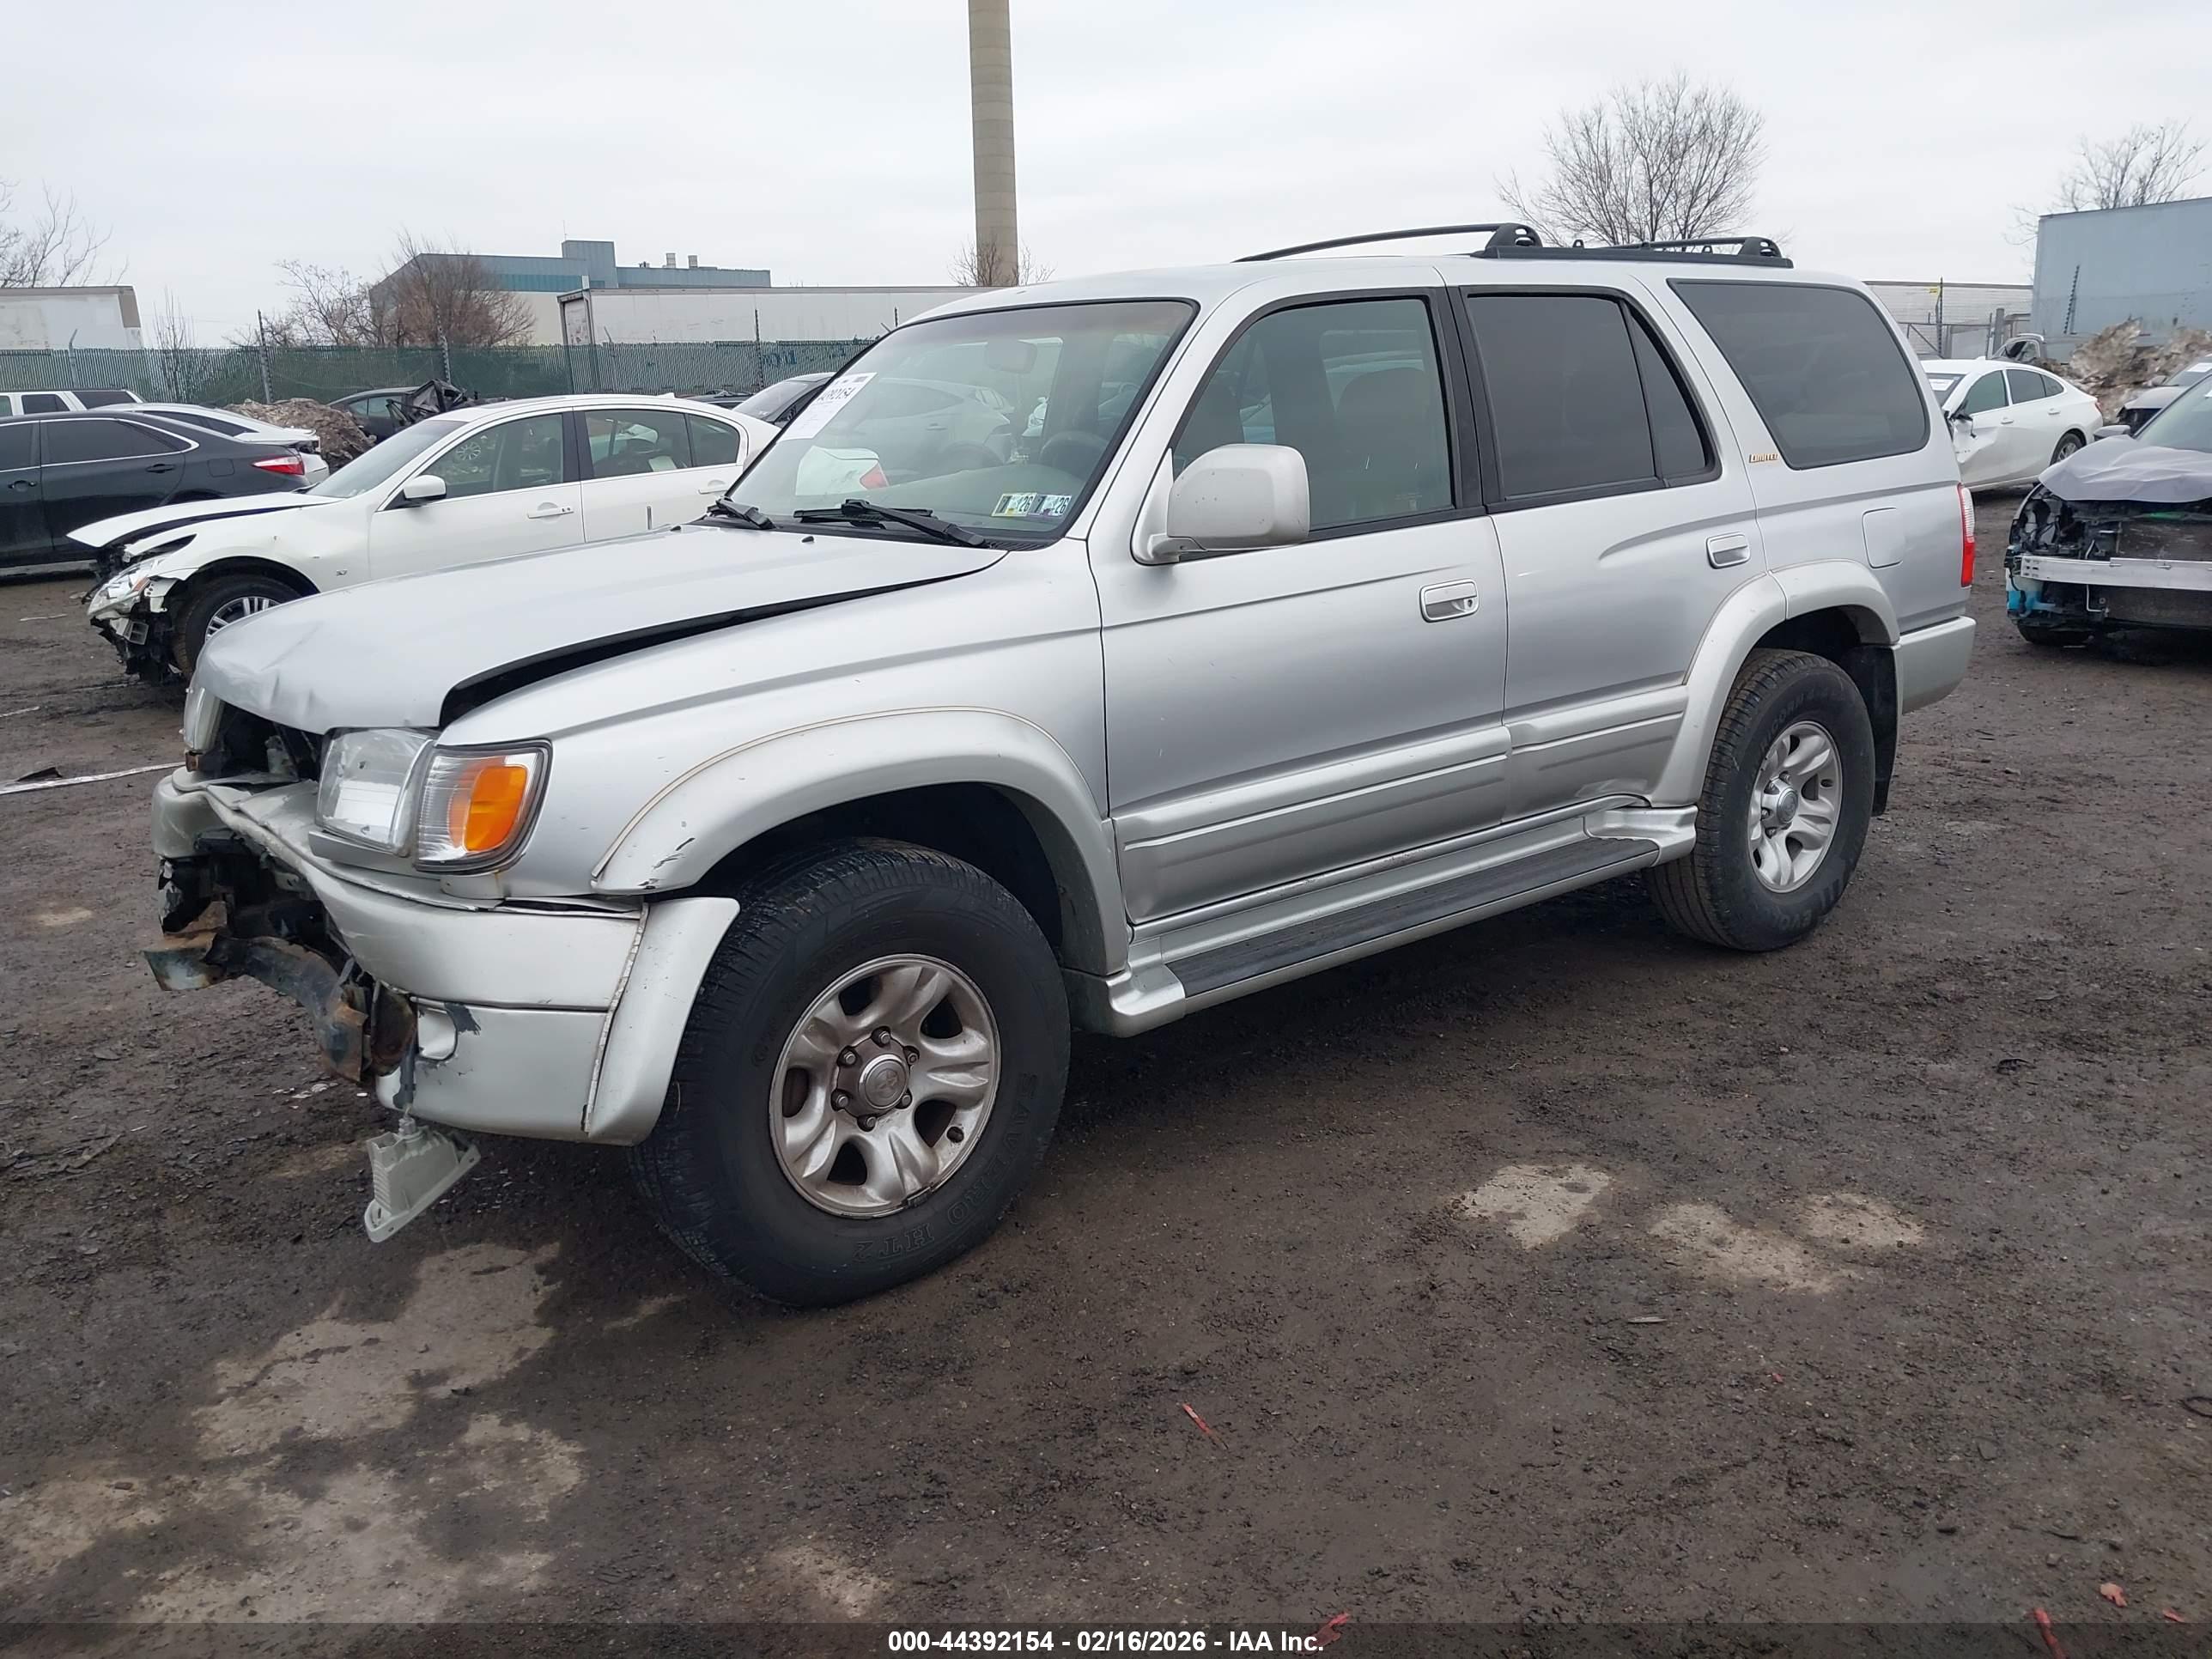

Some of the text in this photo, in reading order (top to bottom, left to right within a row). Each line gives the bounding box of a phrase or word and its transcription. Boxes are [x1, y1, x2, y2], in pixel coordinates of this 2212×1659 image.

[1018, 495, 1034, 513] 26
[1054, 497, 1070, 514] 26
[852, 1072, 1039, 1264] SAVERO HT2
